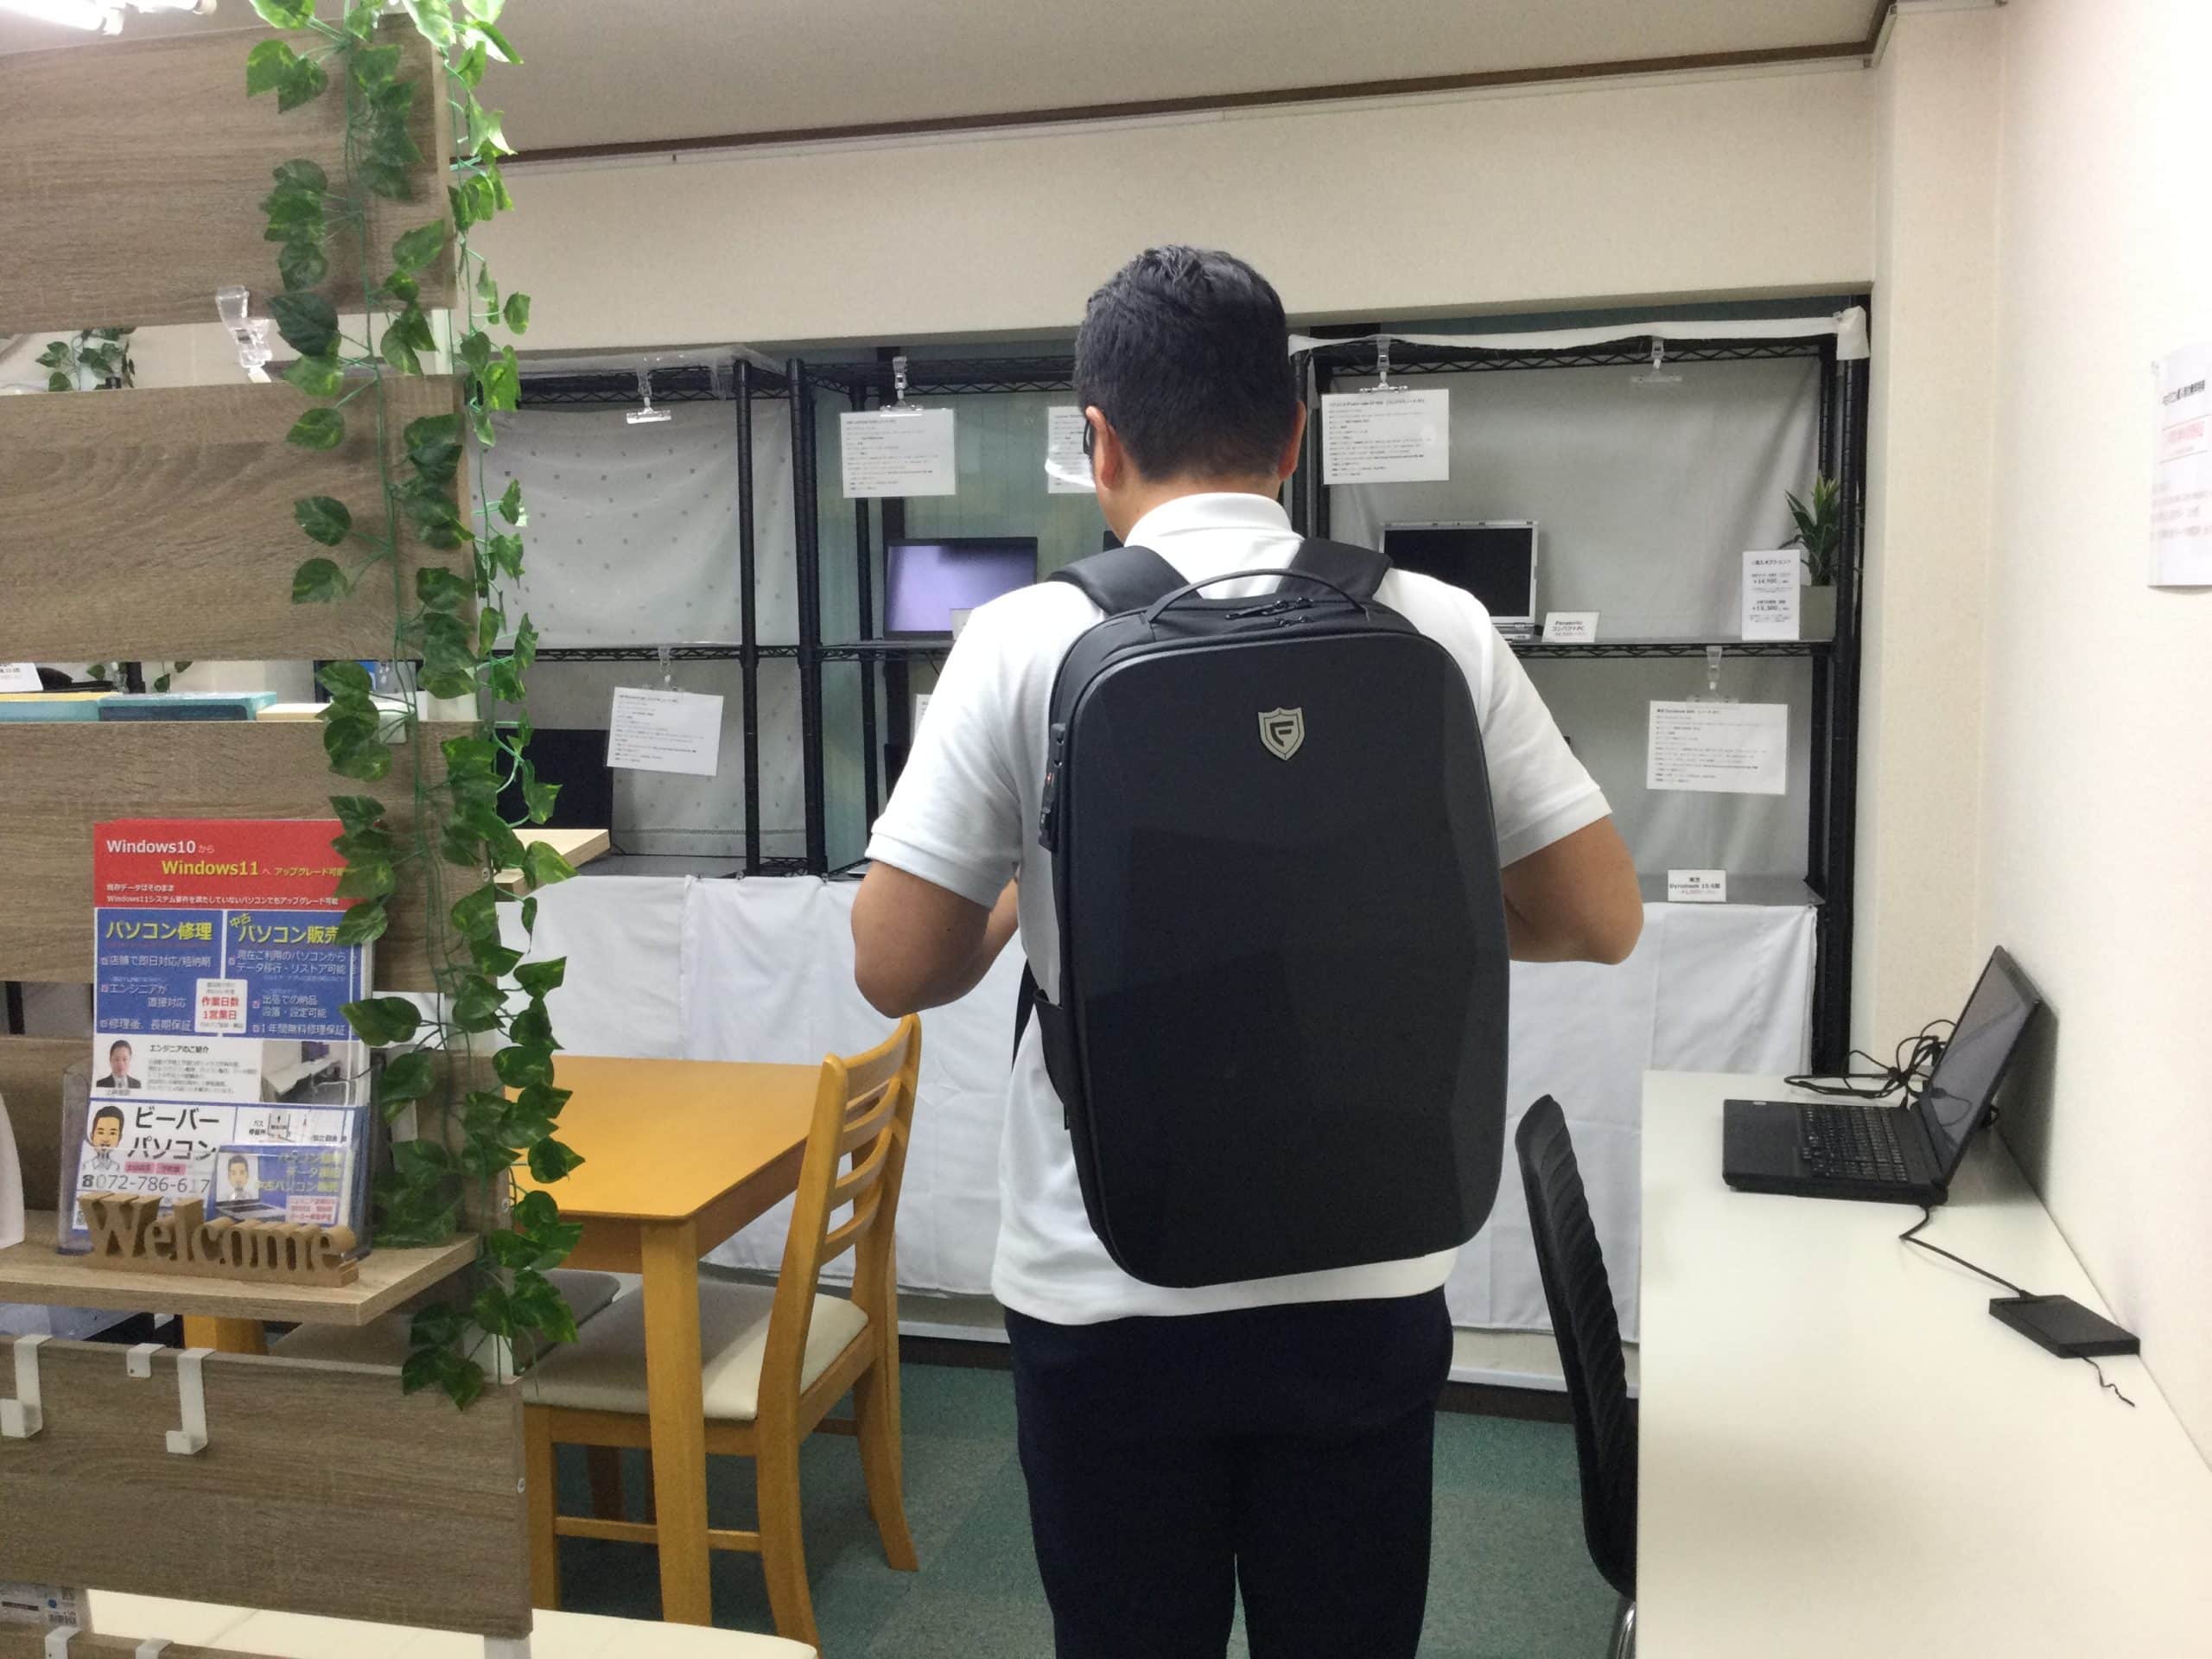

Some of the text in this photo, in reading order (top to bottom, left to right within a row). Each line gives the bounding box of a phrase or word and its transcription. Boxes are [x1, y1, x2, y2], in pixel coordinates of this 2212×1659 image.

[106, 839, 196, 854] Windows10
[162, 860, 258, 875] Windows11
[230, 912, 252, 928] 中古
[106, 921, 213, 941] パソコン修理
[238, 925, 340, 944] パソコン販売
[136, 1105, 219, 1131] ビーバー
[127, 1135, 216, 1160] パソコン
[79, 1192, 357, 1274] Welcome
